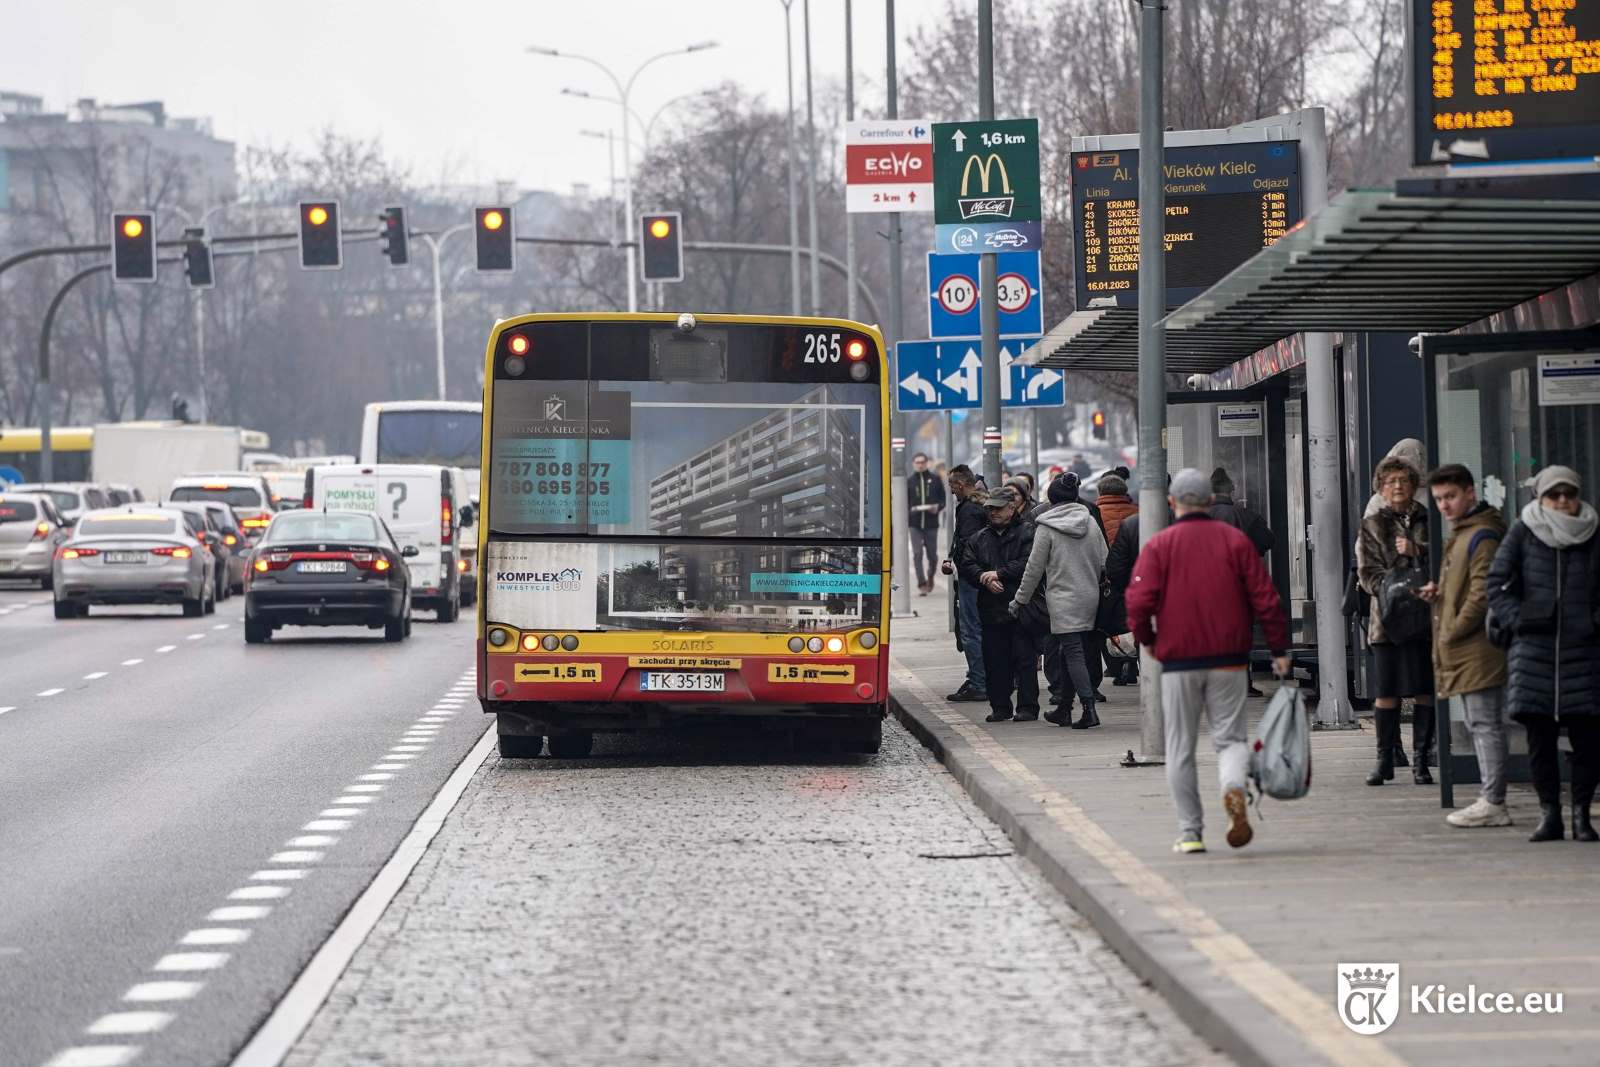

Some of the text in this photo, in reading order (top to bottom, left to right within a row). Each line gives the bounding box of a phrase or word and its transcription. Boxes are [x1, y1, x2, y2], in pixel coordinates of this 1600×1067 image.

[1434, 110, 1513, 130] 16.01.2023
[860, 128, 904, 138] Carrefour
[981, 132, 1026, 148] 1,6 km
[1113, 167, 1132, 181] Al.
[1220, 161, 1256, 175] Kielc
[1253, 178, 1289, 190] Odjazd
[873, 193, 901, 202] 2 km
[1086, 188, 1110, 197] Linia
[1084, 202, 1095, 210] 47
[1107, 200, 1136, 209] KRAJNO
[1085, 229, 1096, 237] 25
[961, 234, 972, 244] 24
[1086, 238, 1101, 246] 109
[1086, 247, 1101, 255] 106
[1086, 256, 1096, 264] 21
[1086, 265, 1097, 273] 25
[1087, 281, 1130, 290] 16.01.2023
[804, 333, 841, 363] 265
[552, 424, 611, 435] KIELCZNKA
[499, 462, 610, 477] 787 808 877
[538, 481, 572, 495] 695
[576, 481, 610, 496] 205
[497, 572, 560, 582] KOMPLEX
[552, 582, 581, 592] BUD
[652, 640, 715, 651] SOLARIS
[639, 657, 731, 667] zachodzi przy skręcie
[554, 667, 596, 680] 1,5 m
[775, 666, 819, 680] 1,5 m
[651, 674, 722, 689] TK 3513M
